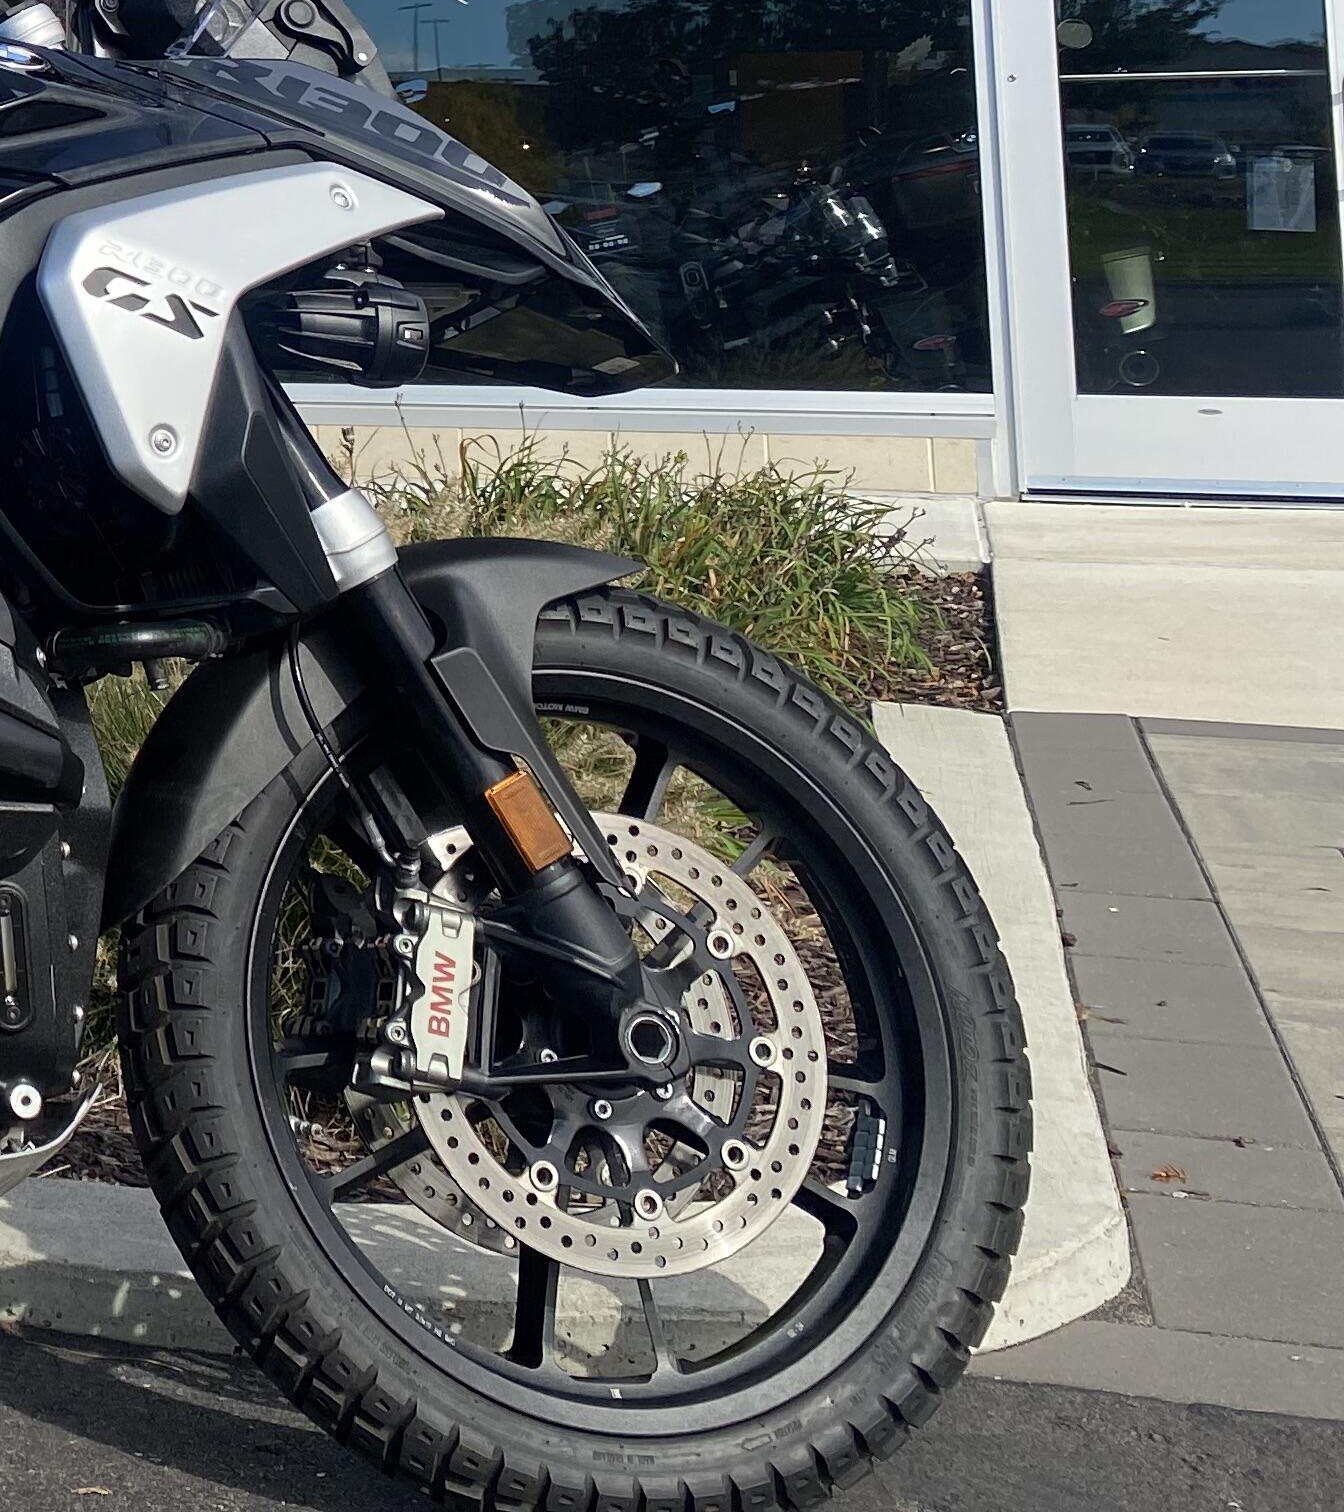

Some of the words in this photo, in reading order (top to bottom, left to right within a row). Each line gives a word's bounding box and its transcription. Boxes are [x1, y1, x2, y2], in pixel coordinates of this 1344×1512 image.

[170, 58, 508, 190] R1300
[82, 266, 220, 339] GS
[99, 240, 224, 297] R1300
[427, 950, 457, 1038] BMW
